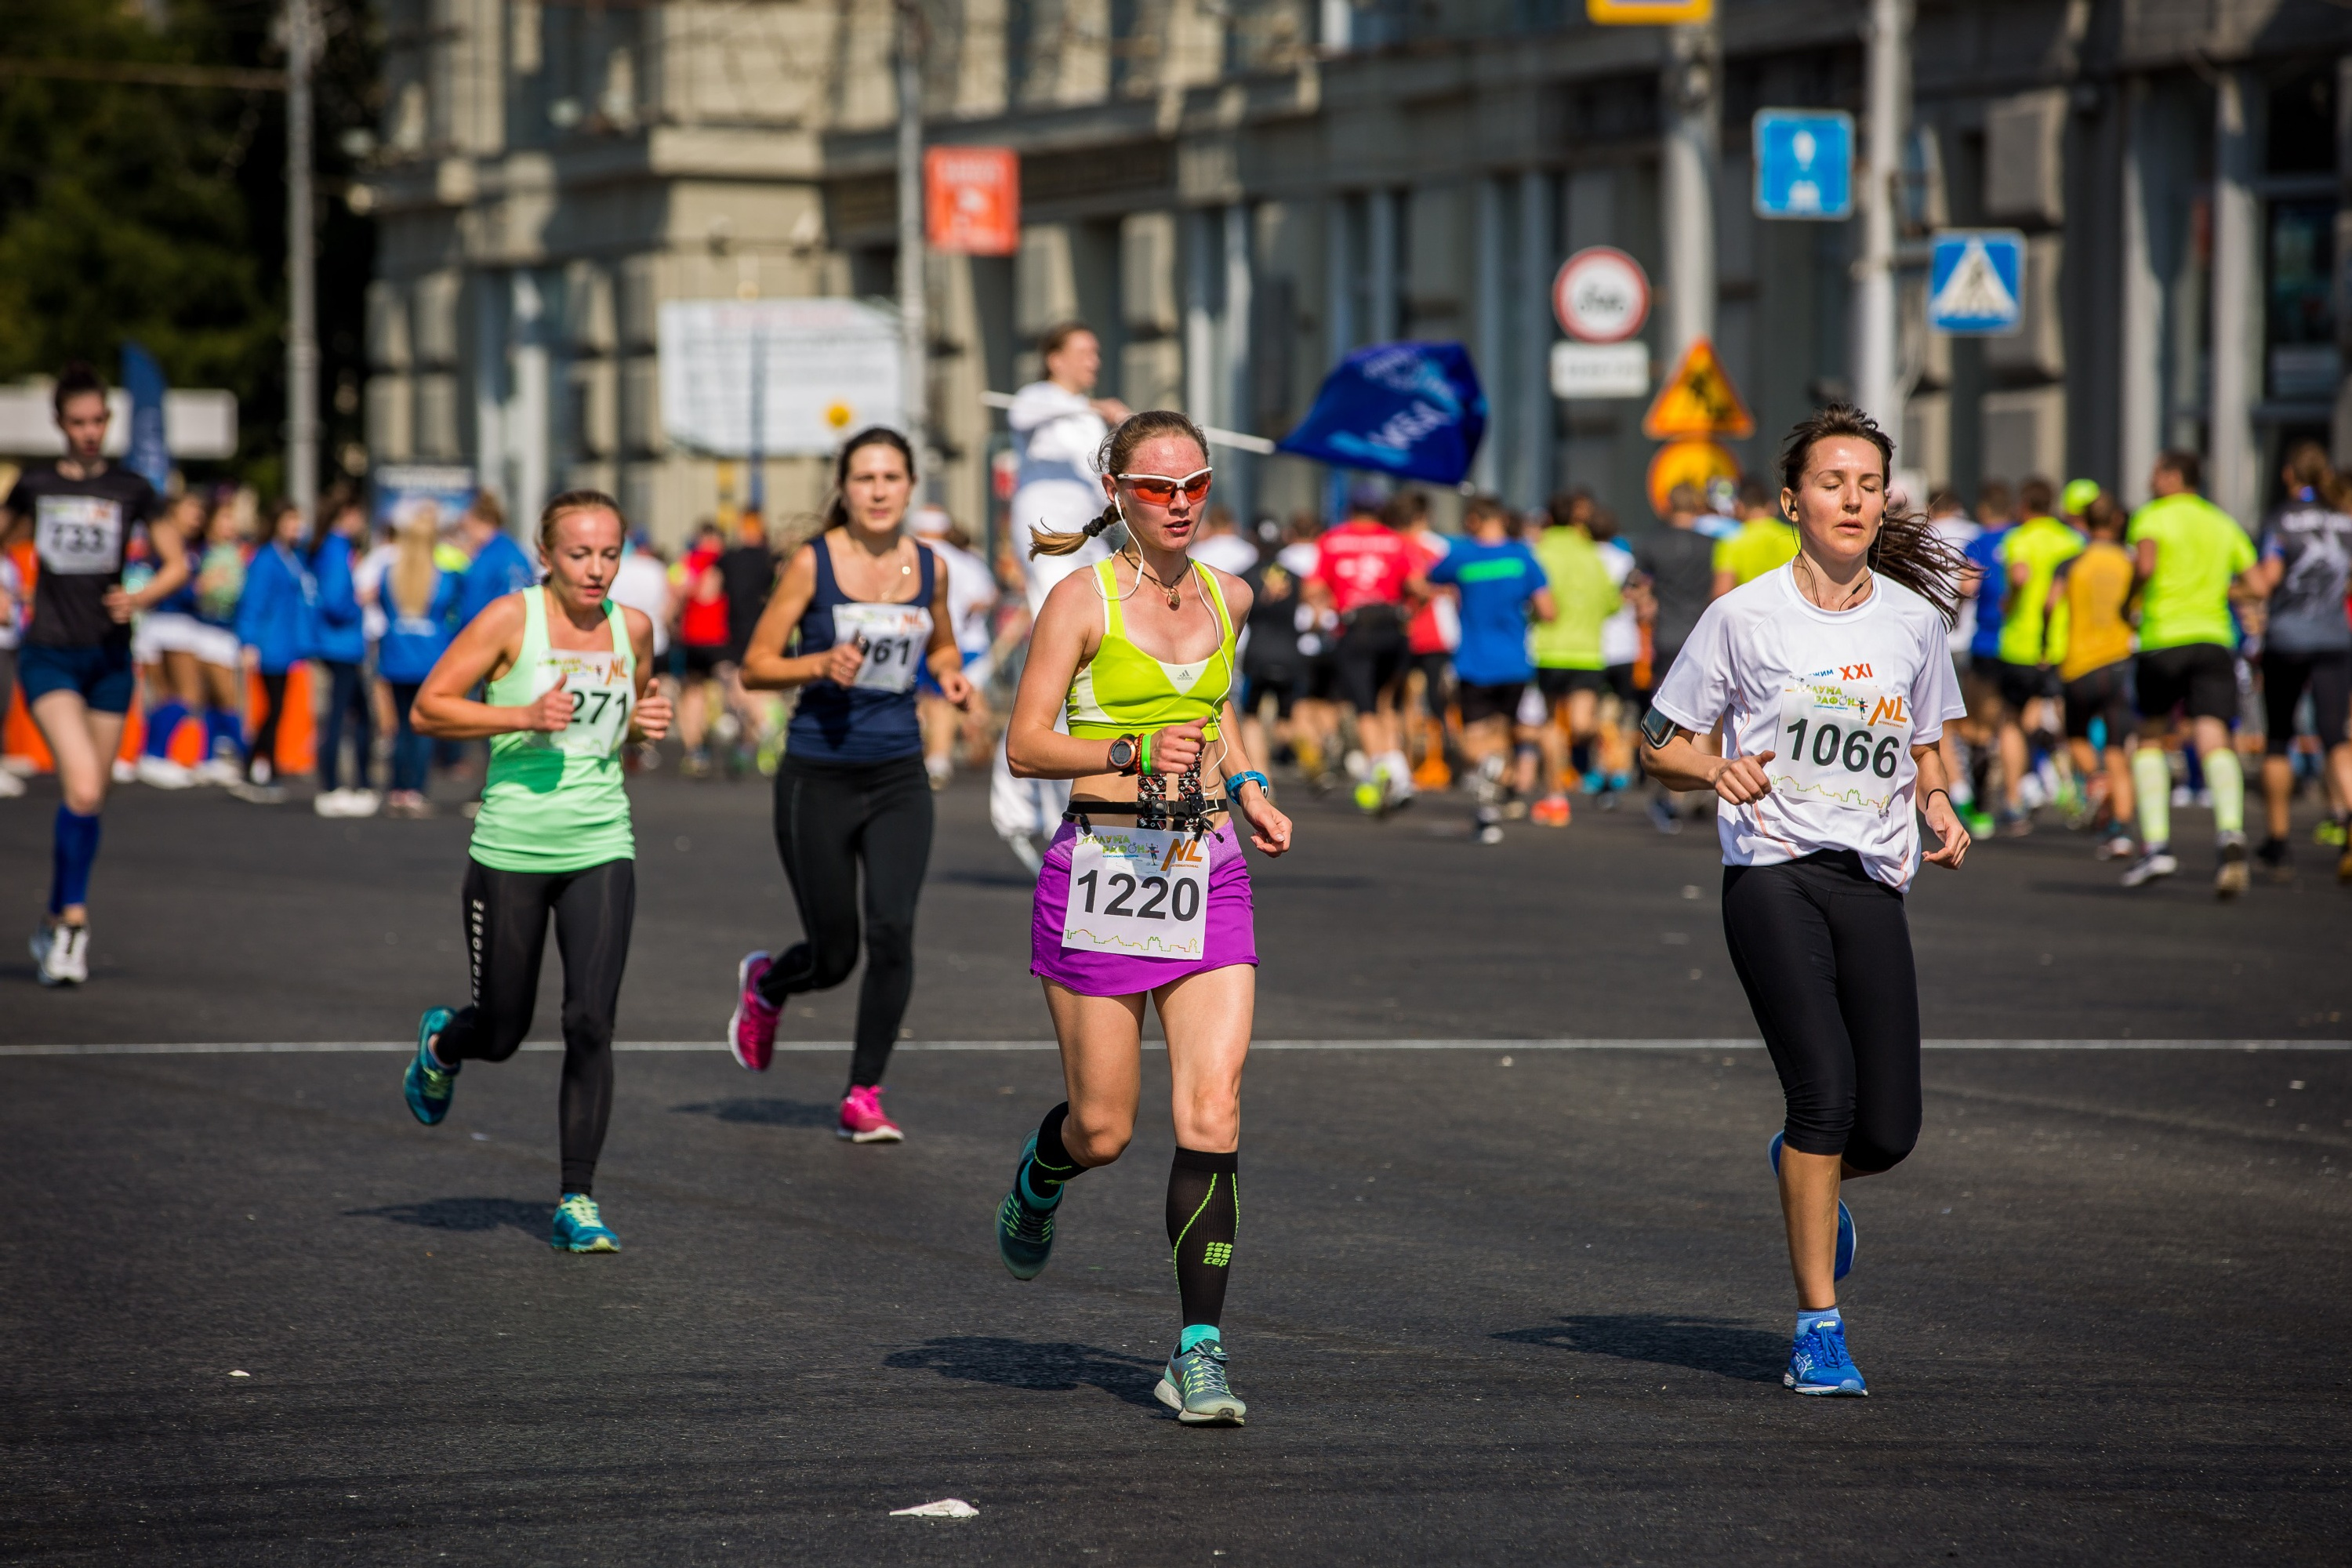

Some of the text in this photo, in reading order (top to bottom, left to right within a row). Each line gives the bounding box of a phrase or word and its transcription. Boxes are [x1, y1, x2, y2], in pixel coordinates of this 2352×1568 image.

[604, 656, 627, 685] NL
[1838, 663, 1873, 681] XXI
[1867, 695, 1907, 726] NL
[1787, 718, 1900, 779] 1066
[1160, 839, 1203, 871] NL
[1077, 869, 1200, 922] 1220
